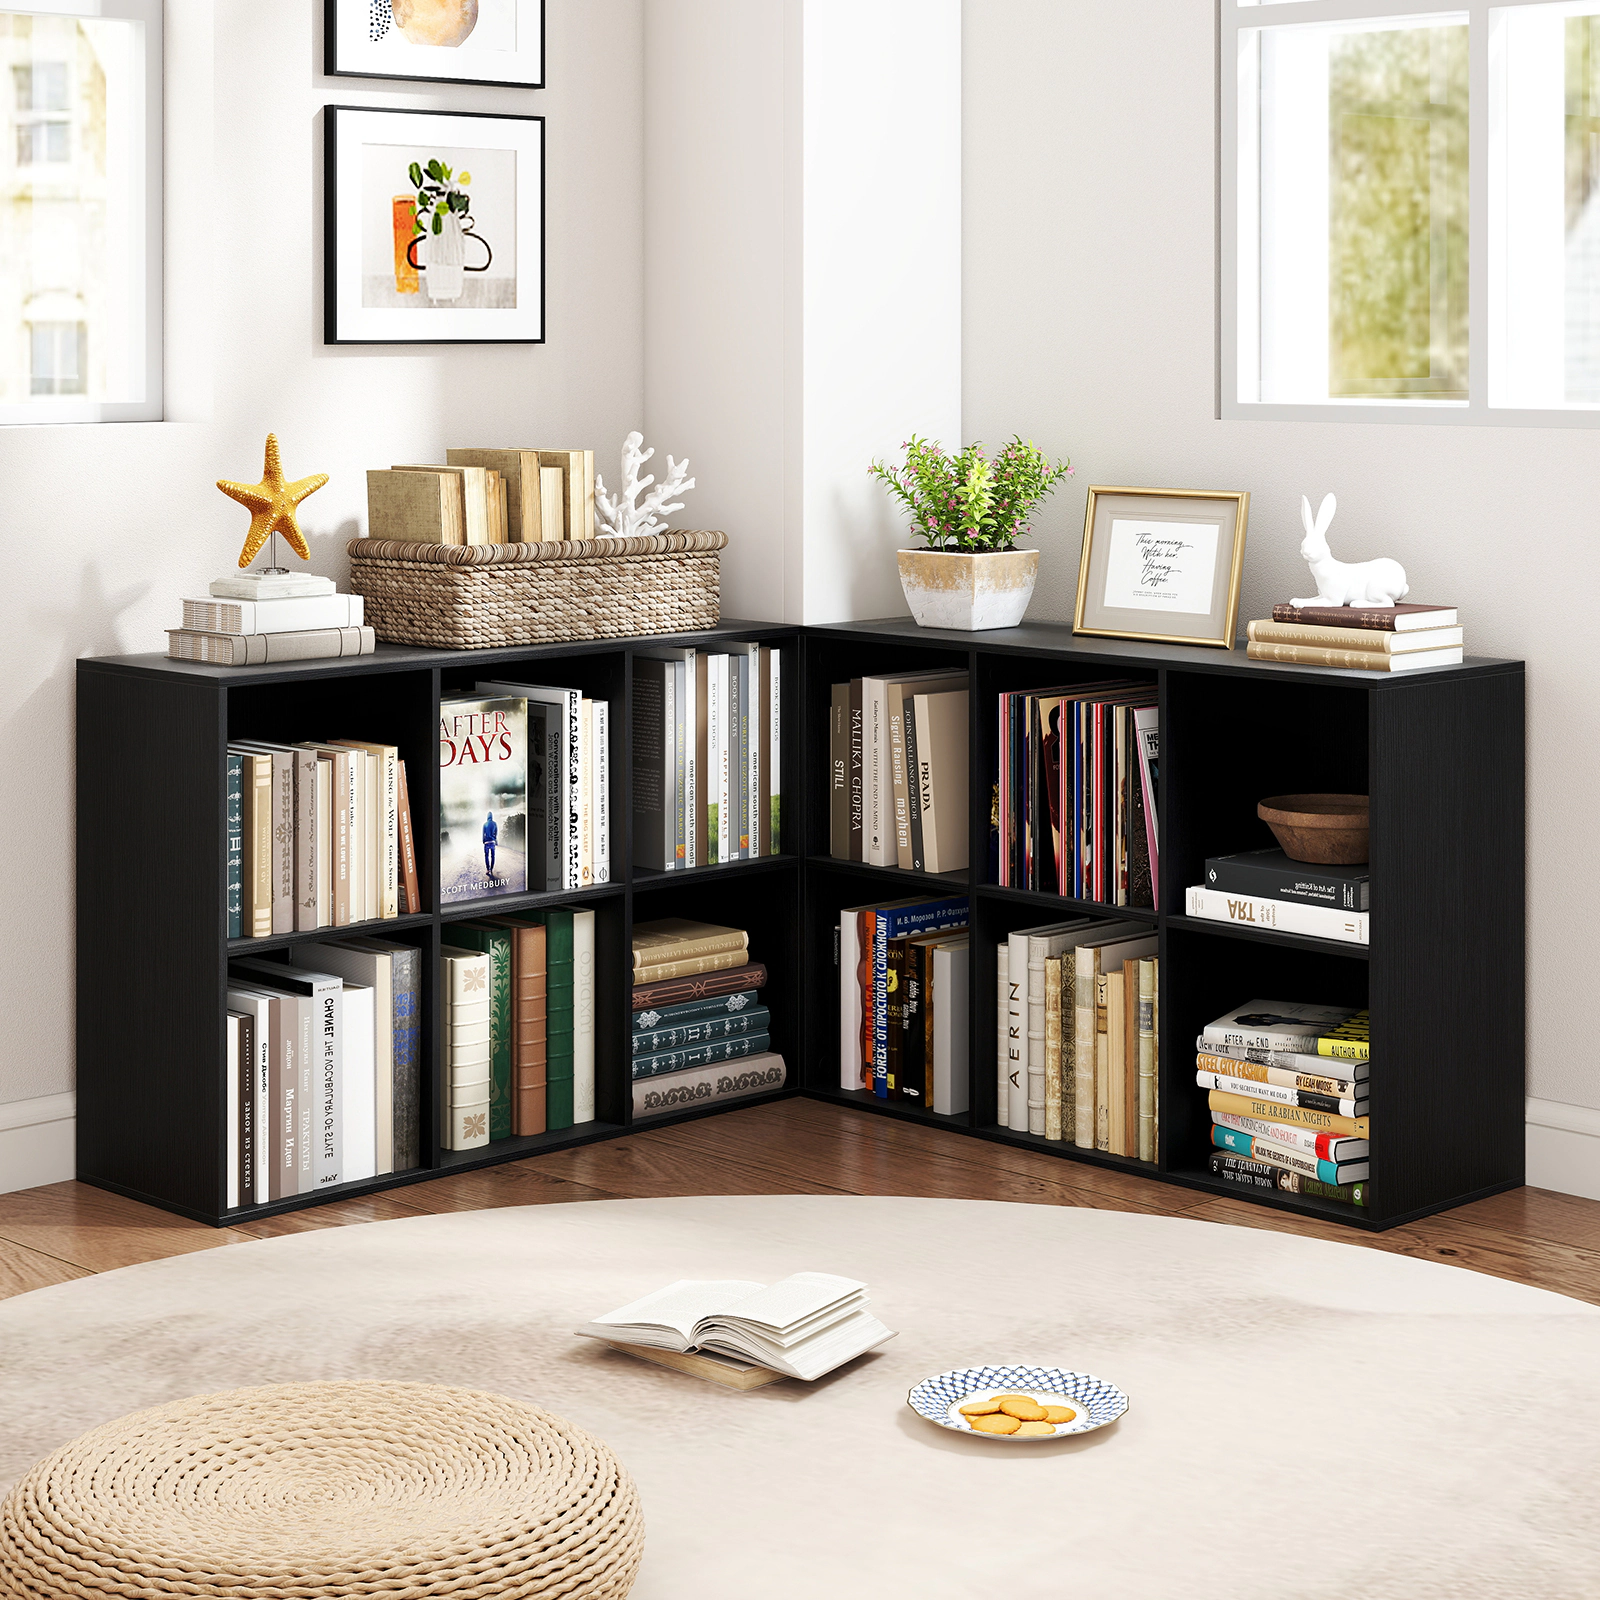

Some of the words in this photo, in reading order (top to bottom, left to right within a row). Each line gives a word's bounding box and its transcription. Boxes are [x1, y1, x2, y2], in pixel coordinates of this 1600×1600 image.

[1142, 558, 1182, 576] Having
[852, 709, 861, 769] MALLIKA
[891, 715, 902, 744] Sigrid
[834, 760, 844, 790] STILL
[893, 747, 903, 785] Rausing
[921, 761, 930, 811] PRADA
[852, 776, 861, 831] CHOPRA
[896, 798, 908, 847] mayhem
[441, 885, 469, 895] SCOTT
[470, 877, 510, 891] MEDBURY
[910, 912, 935, 924] Морозов
[876, 915, 887, 971] СЛОЖНОМУ
[580, 951, 592, 1035] LUXDECO
[876, 981, 887, 1027] ПРОСТОГО
[302, 1016, 310, 1065] Иммануил
[876, 1029, 887, 1041] ОТ
[1009, 981, 1020, 1089] AERIN
[1224, 1034, 1243, 1046] AFTER
[1256, 1037, 1269, 1048] END
[876, 1044, 887, 1079] FOREX:
[1331, 1046, 1356, 1058] AUTHOR
[302, 1069, 310, 1093] Кант
[1198, 1054, 1219, 1073] STEEL
[1220, 1057, 1236, 1076] CITY
[1237, 1060, 1269, 1083] FASHION
[1296, 1075, 1303, 1086] BY
[1303, 1077, 1315, 1089] LEAH
[284, 1088, 294, 1133] Мартин
[1251, 1102, 1266, 1115] THE
[1267, 1105, 1301, 1122] ARABIAN
[1302, 1111, 1332, 1127] NIGHTS
[284, 1138, 294, 1168] Иден
[302, 1108, 310, 1172] ТРАКТАТЫ
